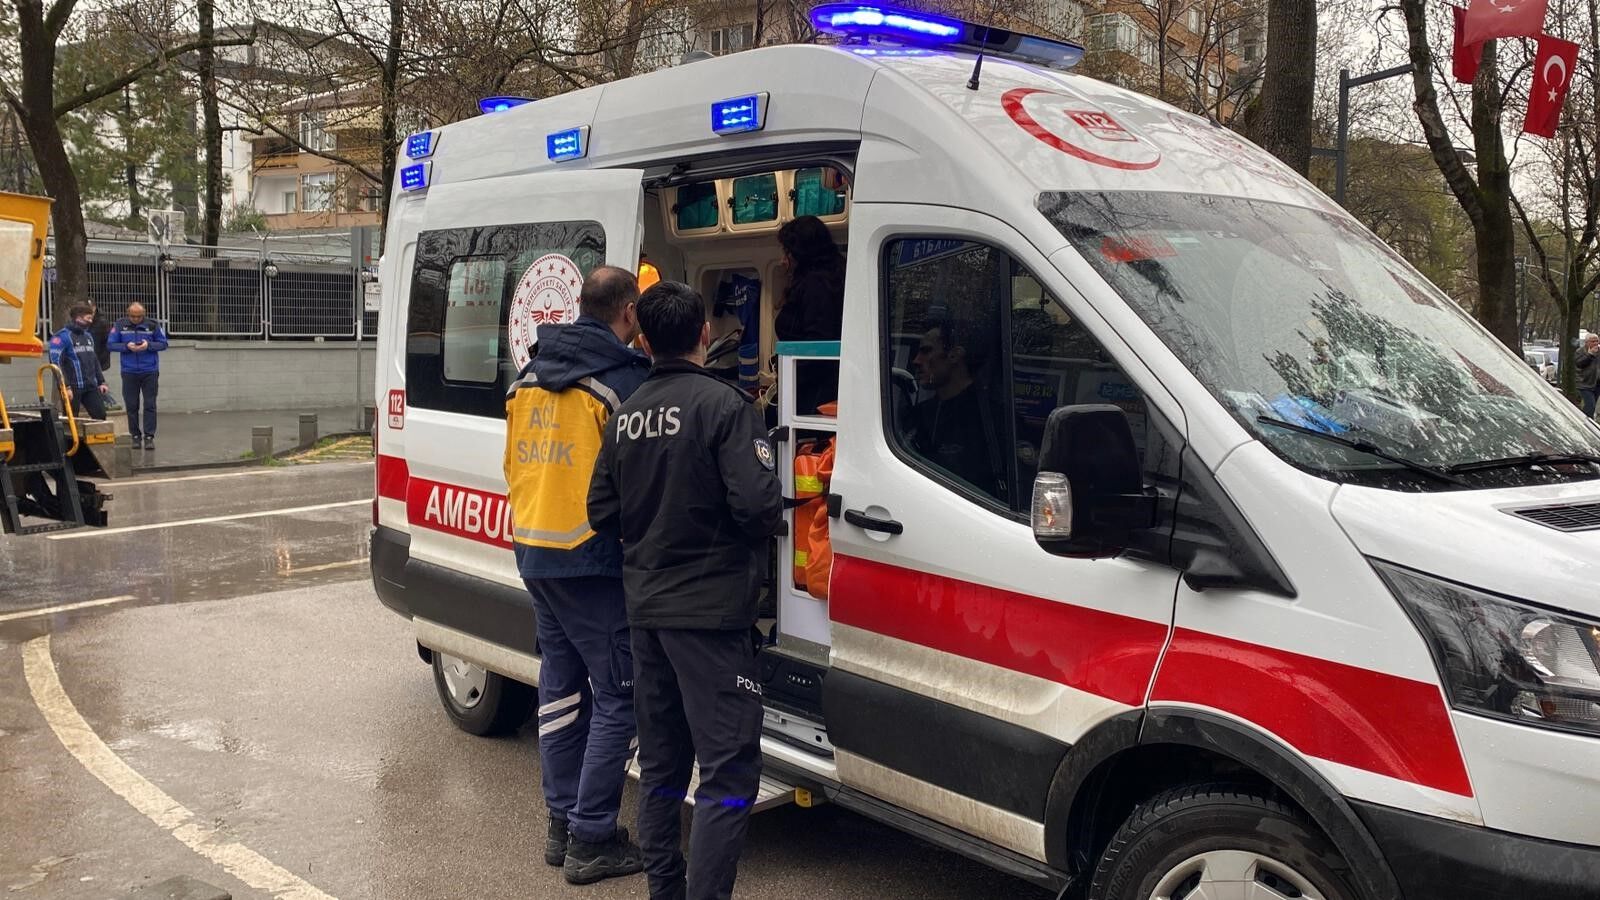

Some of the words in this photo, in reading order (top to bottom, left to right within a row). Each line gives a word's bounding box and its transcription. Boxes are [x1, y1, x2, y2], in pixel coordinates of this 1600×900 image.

[1073, 113, 1118, 128] 112
[390, 394, 403, 413] 112
[424, 485, 514, 543] AMBUL
